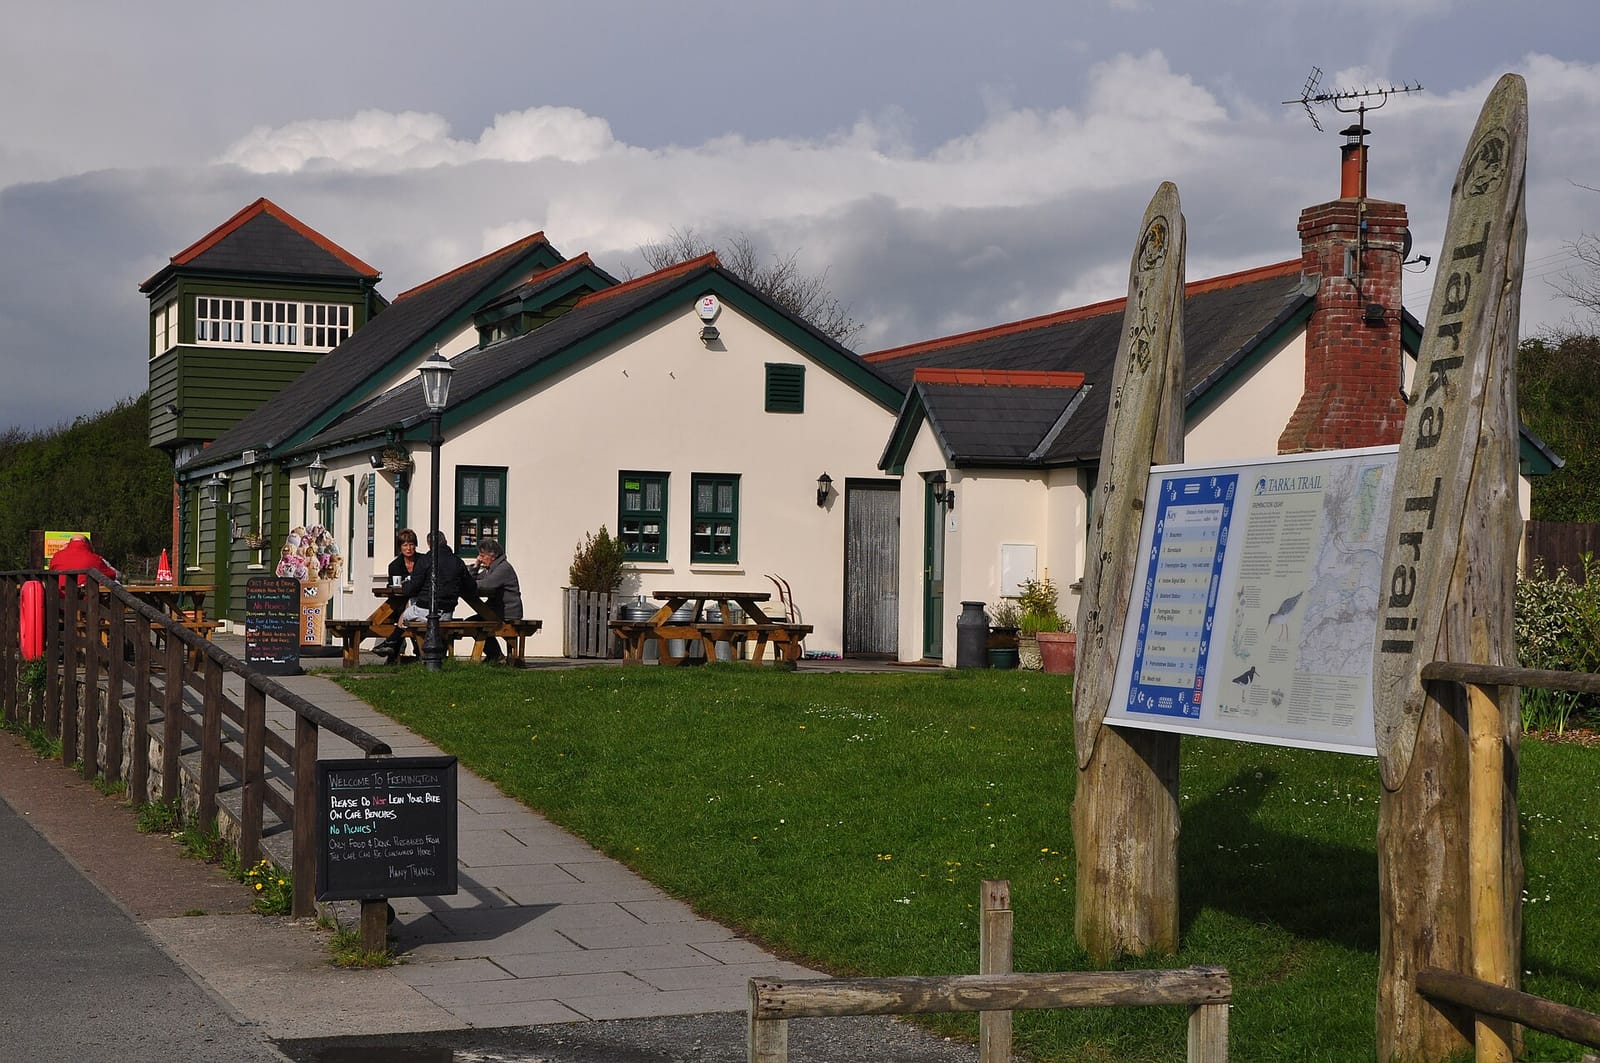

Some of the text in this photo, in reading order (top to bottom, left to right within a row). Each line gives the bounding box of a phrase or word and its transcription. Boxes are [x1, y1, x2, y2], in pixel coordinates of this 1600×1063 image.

[1115, 386, 1121, 399] 5
[1381, 221, 1491, 654] Tarka Trail
[1103, 482, 1109, 494] 6
[1268, 475, 1322, 492] TARKA TRAIL
[1107, 552, 1113, 565] 8
[329, 773, 369, 787] WELCOME
[386, 772, 439, 785] FREMINGTON
[331, 796, 358, 808] PLEASE
[365, 808, 397, 820] BENCHES
